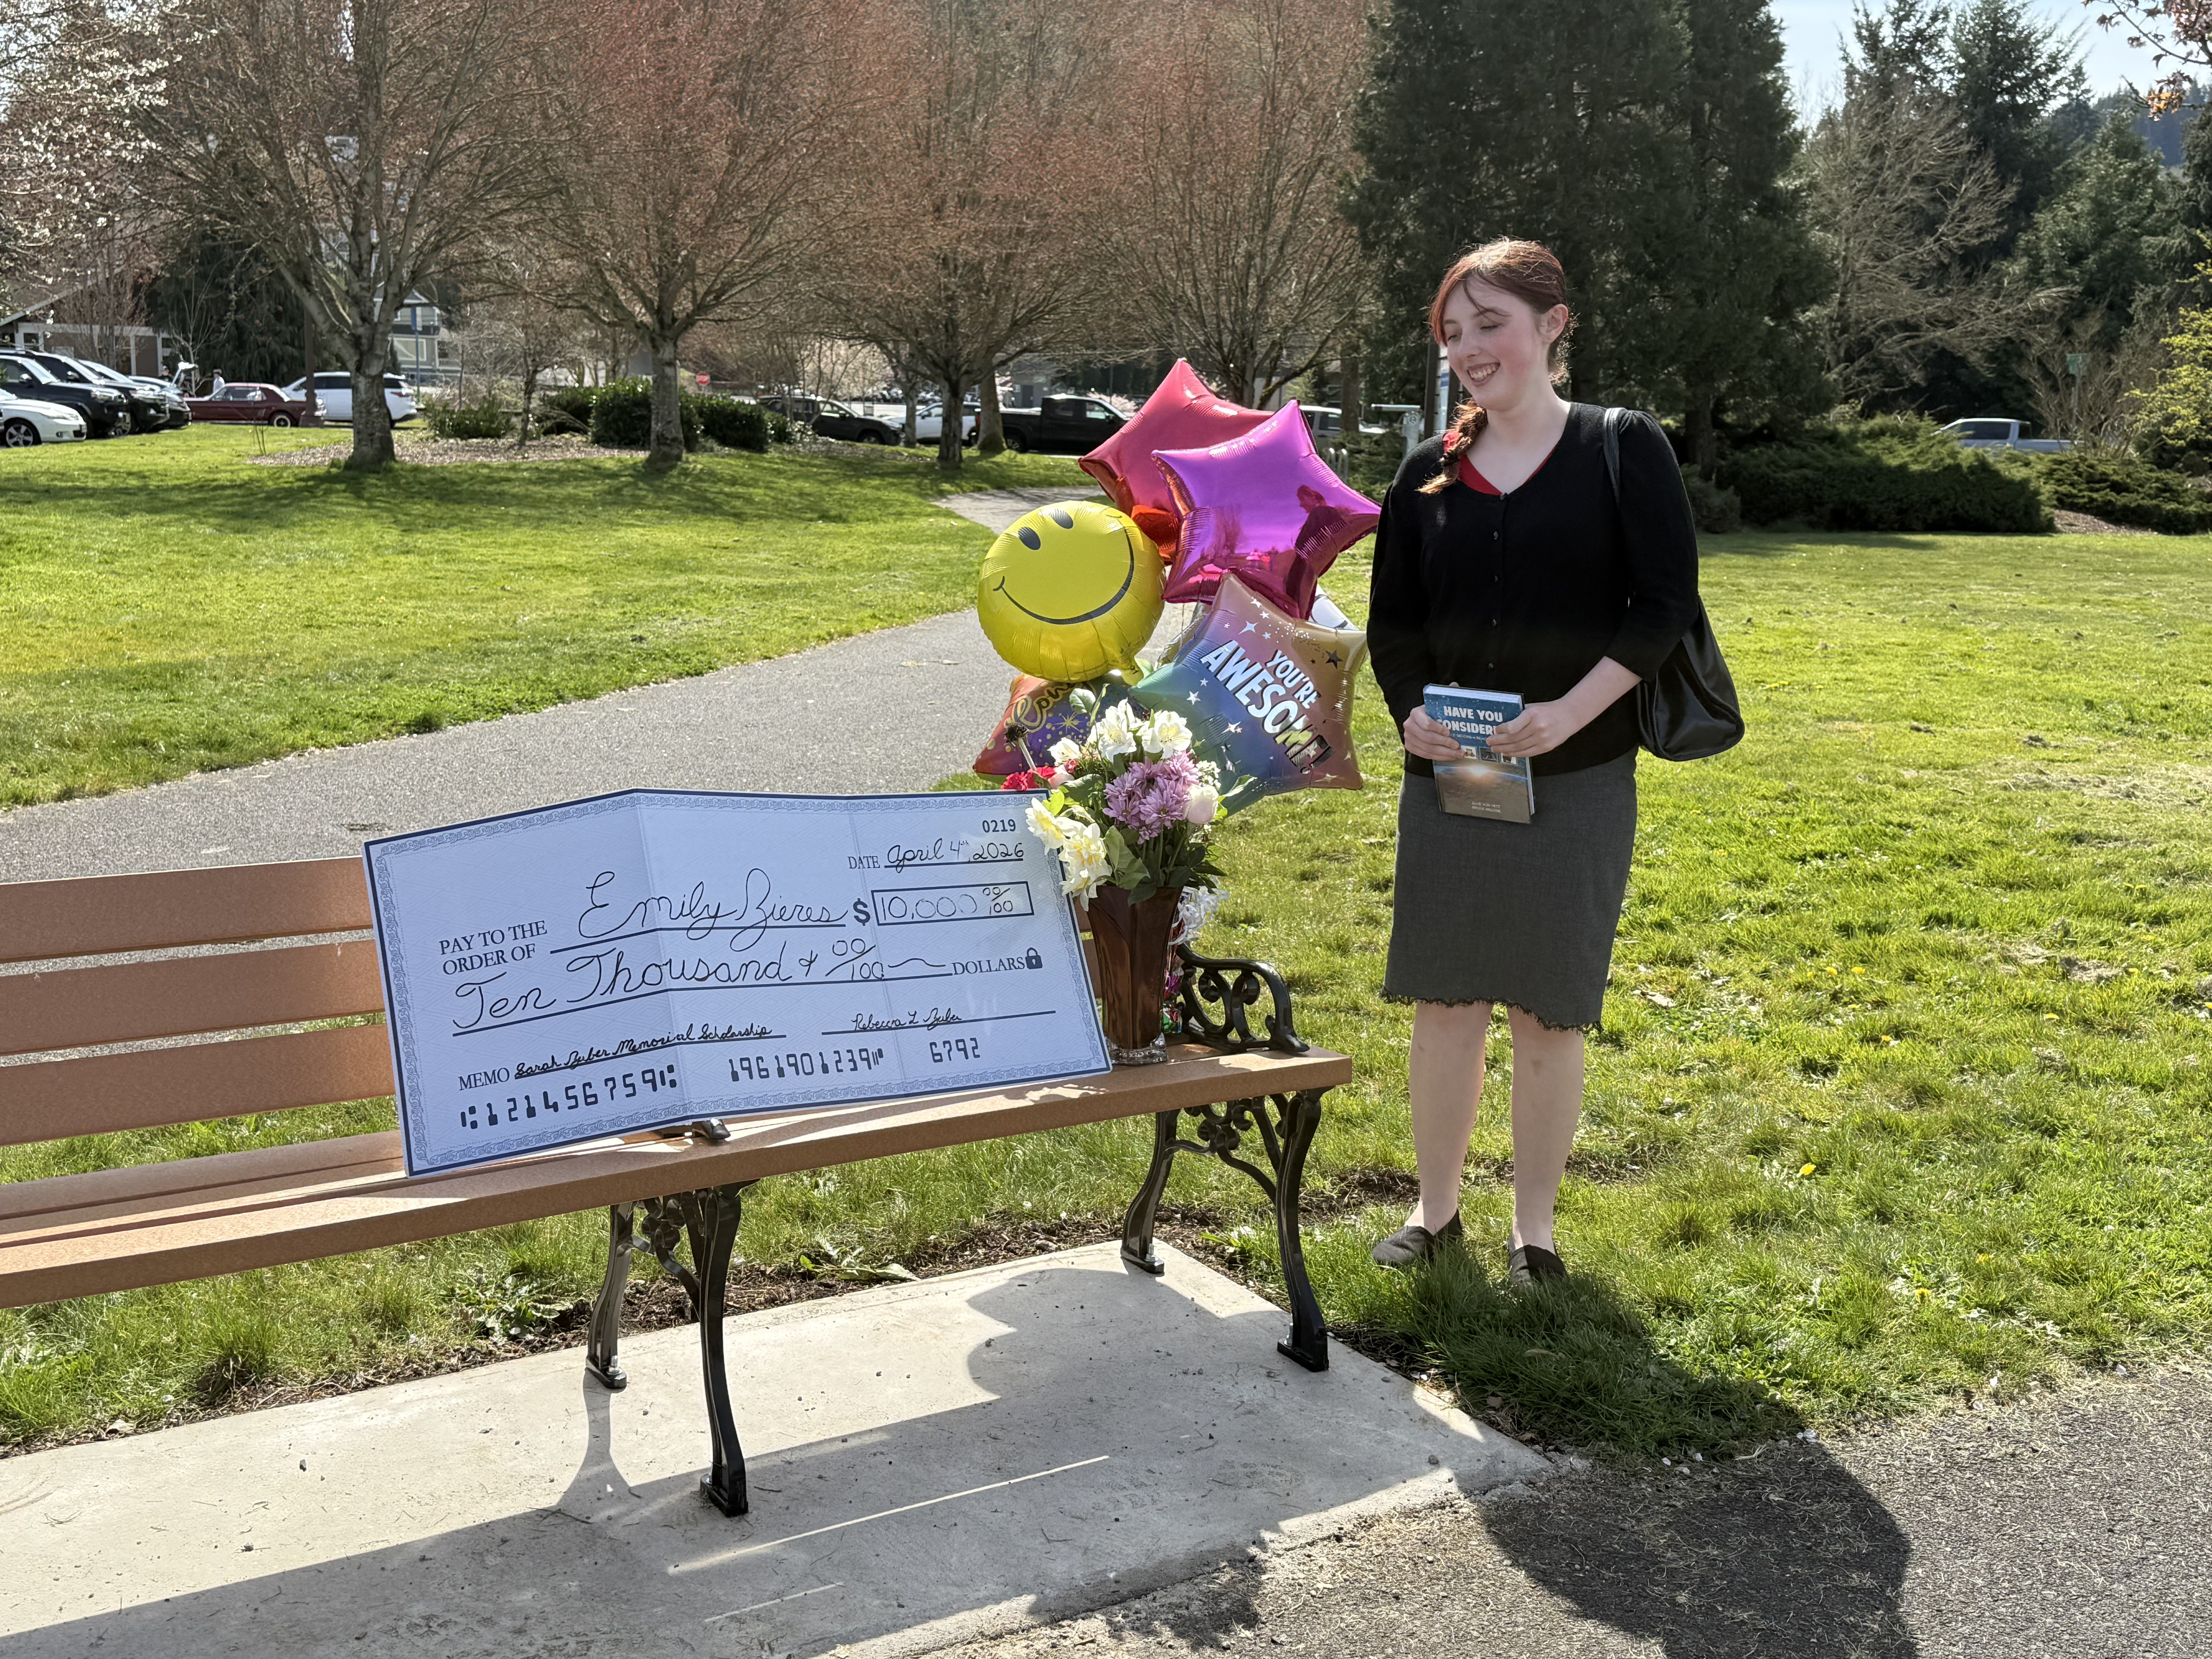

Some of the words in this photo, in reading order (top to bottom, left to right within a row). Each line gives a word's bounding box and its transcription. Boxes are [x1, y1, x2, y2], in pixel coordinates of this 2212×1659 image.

[1266, 650, 1318, 709] YOU'RE
[1201, 640, 1334, 774] AWESOME!
[1443, 706, 1474, 720] HAVE
[1476, 709, 1503, 723] YOU
[1436, 719, 1497, 735] ONSIDER
[982, 819, 1017, 833] 0219
[847, 856, 880, 869] DATE
[972, 842, 1024, 860] 2026
[578, 871, 738, 941] Emily
[438, 935, 475, 955] PAY
[478, 929, 506, 947] TO
[508, 920, 548, 941] THE
[442, 949, 508, 975] ORDER
[511, 943, 536, 961] OF
[951, 957, 1025, 975] DOLLARS
[452, 971, 557, 1029] Ten
[566, 940, 793, 1002] Thousand
[851, 1013, 907, 1031] Rebecca
[514, 1054, 562, 1076] Sarah
[611, 1023, 696, 1053] Memorial
[697, 1022, 773, 1041] Scholarship
[929, 1037, 981, 1063] 6792
[457, 1067, 510, 1091] MEMO
